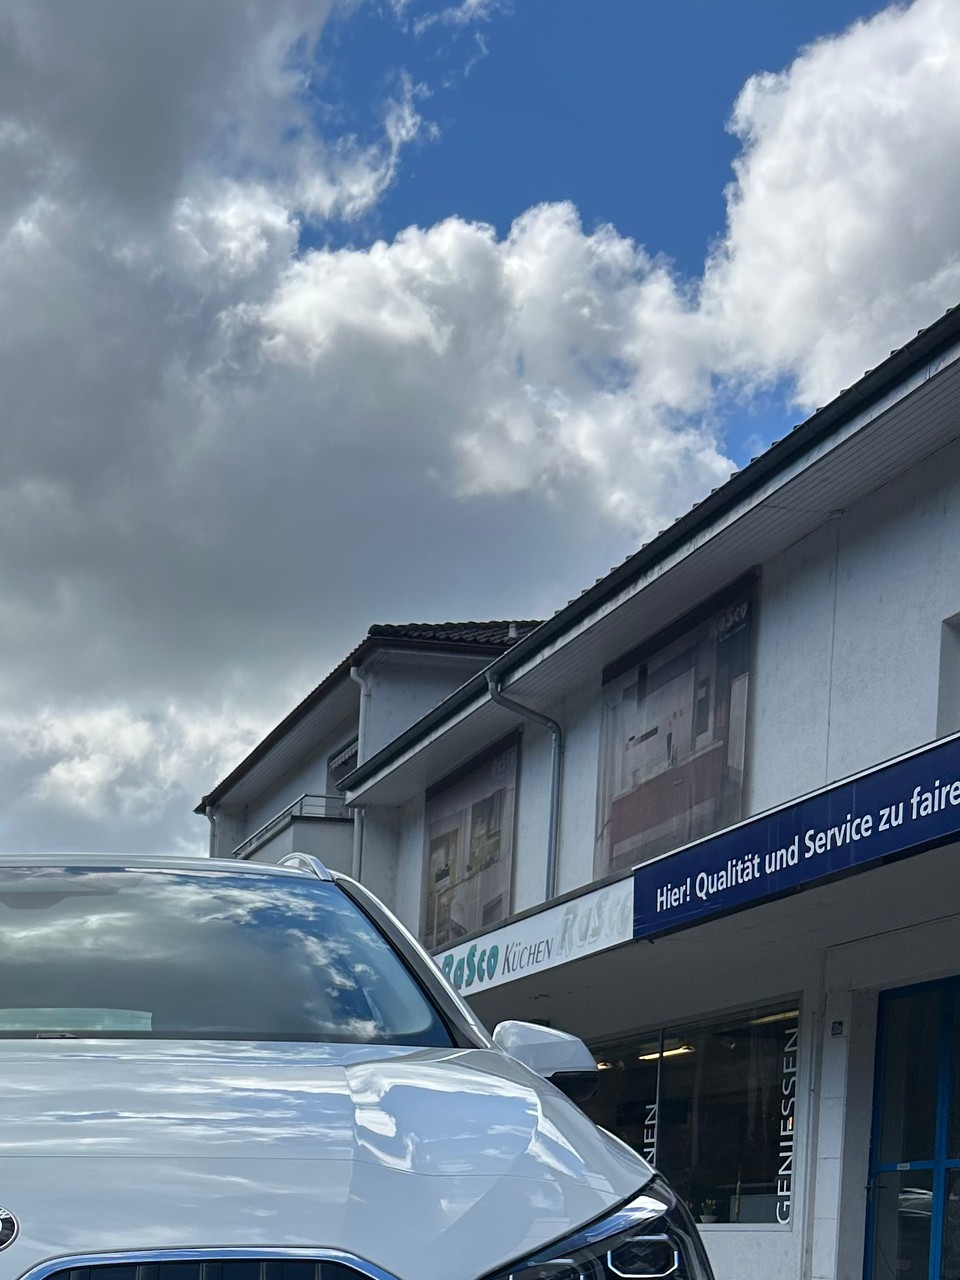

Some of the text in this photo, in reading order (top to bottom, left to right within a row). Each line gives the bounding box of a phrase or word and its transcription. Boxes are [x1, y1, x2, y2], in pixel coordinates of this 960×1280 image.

[656, 780, 960, 912] Hier! Qualität und Service zu faire
[776, 1027, 799, 1226] GENIESSEN
